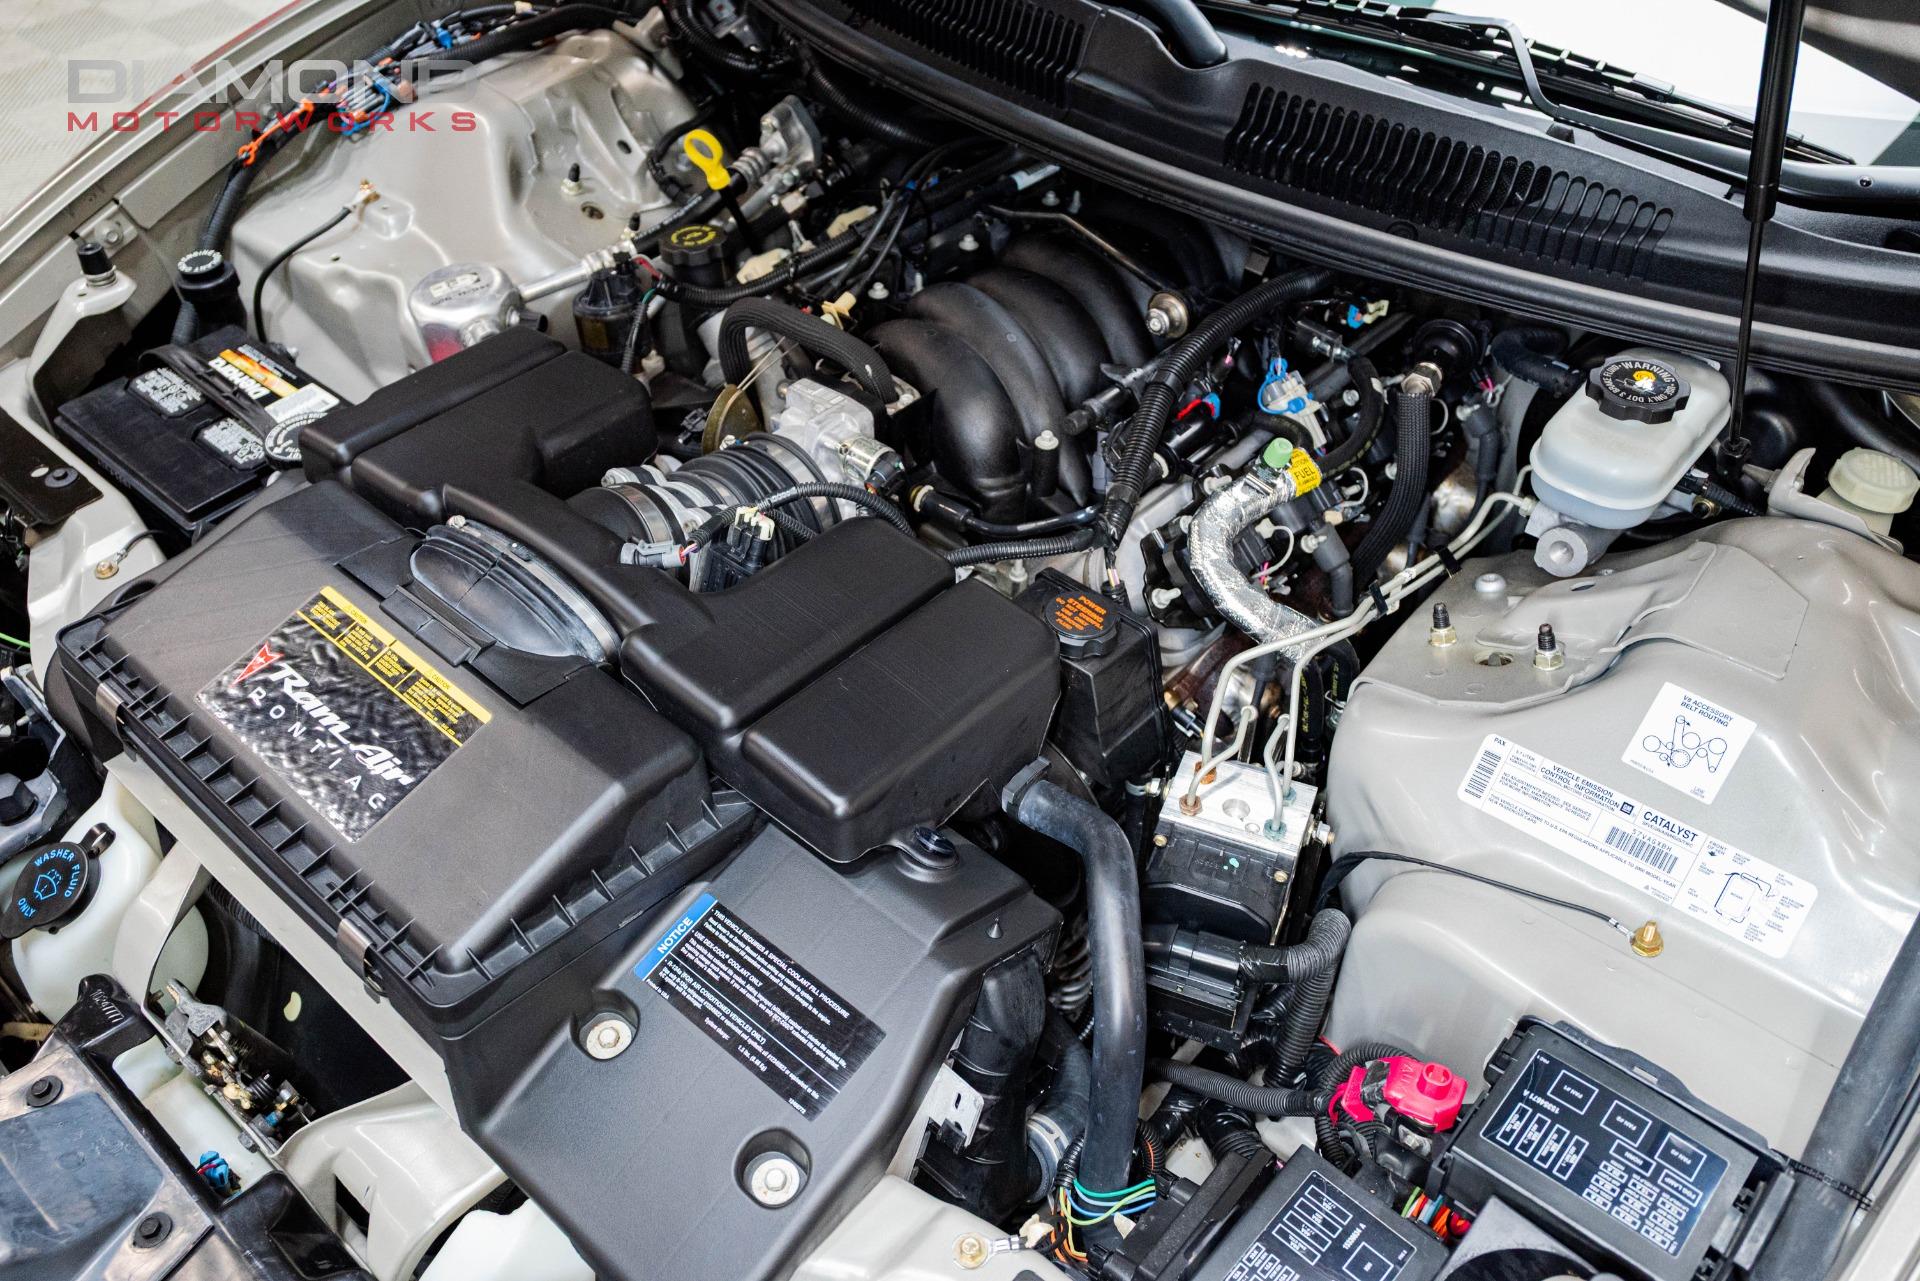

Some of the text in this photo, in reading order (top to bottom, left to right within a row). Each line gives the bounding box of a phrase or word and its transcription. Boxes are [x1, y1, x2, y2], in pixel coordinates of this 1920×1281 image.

[1621, 361, 1674, 383] WARNING
[1603, 377, 1621, 393] BRAKE
[1627, 395, 1645, 403] DOT
[1294, 466, 1315, 480] FUEL
[1067, 597, 1104, 623] STEERING
[1078, 595, 1107, 615] POWER
[1681, 700, 1729, 728] BELT ROUTING
[1693, 699, 1733, 722] ACCESSORY
[268, 662, 357, 747] Ram
[350, 743, 416, 787] Air
[248, 686, 387, 811] PONTIAC
[1493, 737, 1506, 746] PAX
[1540, 766, 1620, 809] CONTROL INFORMATION
[1552, 765, 1614, 798] VEHICLE EMISSION
[1642, 810, 1698, 843] CATALYST
[18, 848, 80, 918] WASHER FLUID ONLY
[656, 916, 693, 955] NOTICE
[693, 931, 705, 942] USE
[727, 957, 751, 978] COOLANT
[748, 974, 764, 988] ONLY
[713, 910, 726, 921] THIS
[722, 917, 744, 935] VEHICLE
[741, 932, 766, 953] REQUIRES
[767, 952, 789, 971] SPECIAL
[786, 967, 811, 988] COOLANT
[808, 984, 821, 996] FILL
[818, 992, 850, 1019] PROCEDURE
[680, 972, 694, 984] (FOR
[691, 981, 702, 991] AIR
[698, 988, 731, 1015] CONDITIONED
[728, 1012, 753, 1033] VEHICLES
[750, 1030, 767, 1045] ONLY)
[1522, 1088, 1531, 1097] A
[1562, 1084, 1584, 1100] FAN #1
[1624, 1120, 1637, 1131] FAN
[1624, 1150, 1644, 1166] HORN
[1678, 1153, 1692, 1165] FAN
[1663, 1175, 1697, 1200] FOG LAMP
[1358, 1222, 1367, 1230] A
